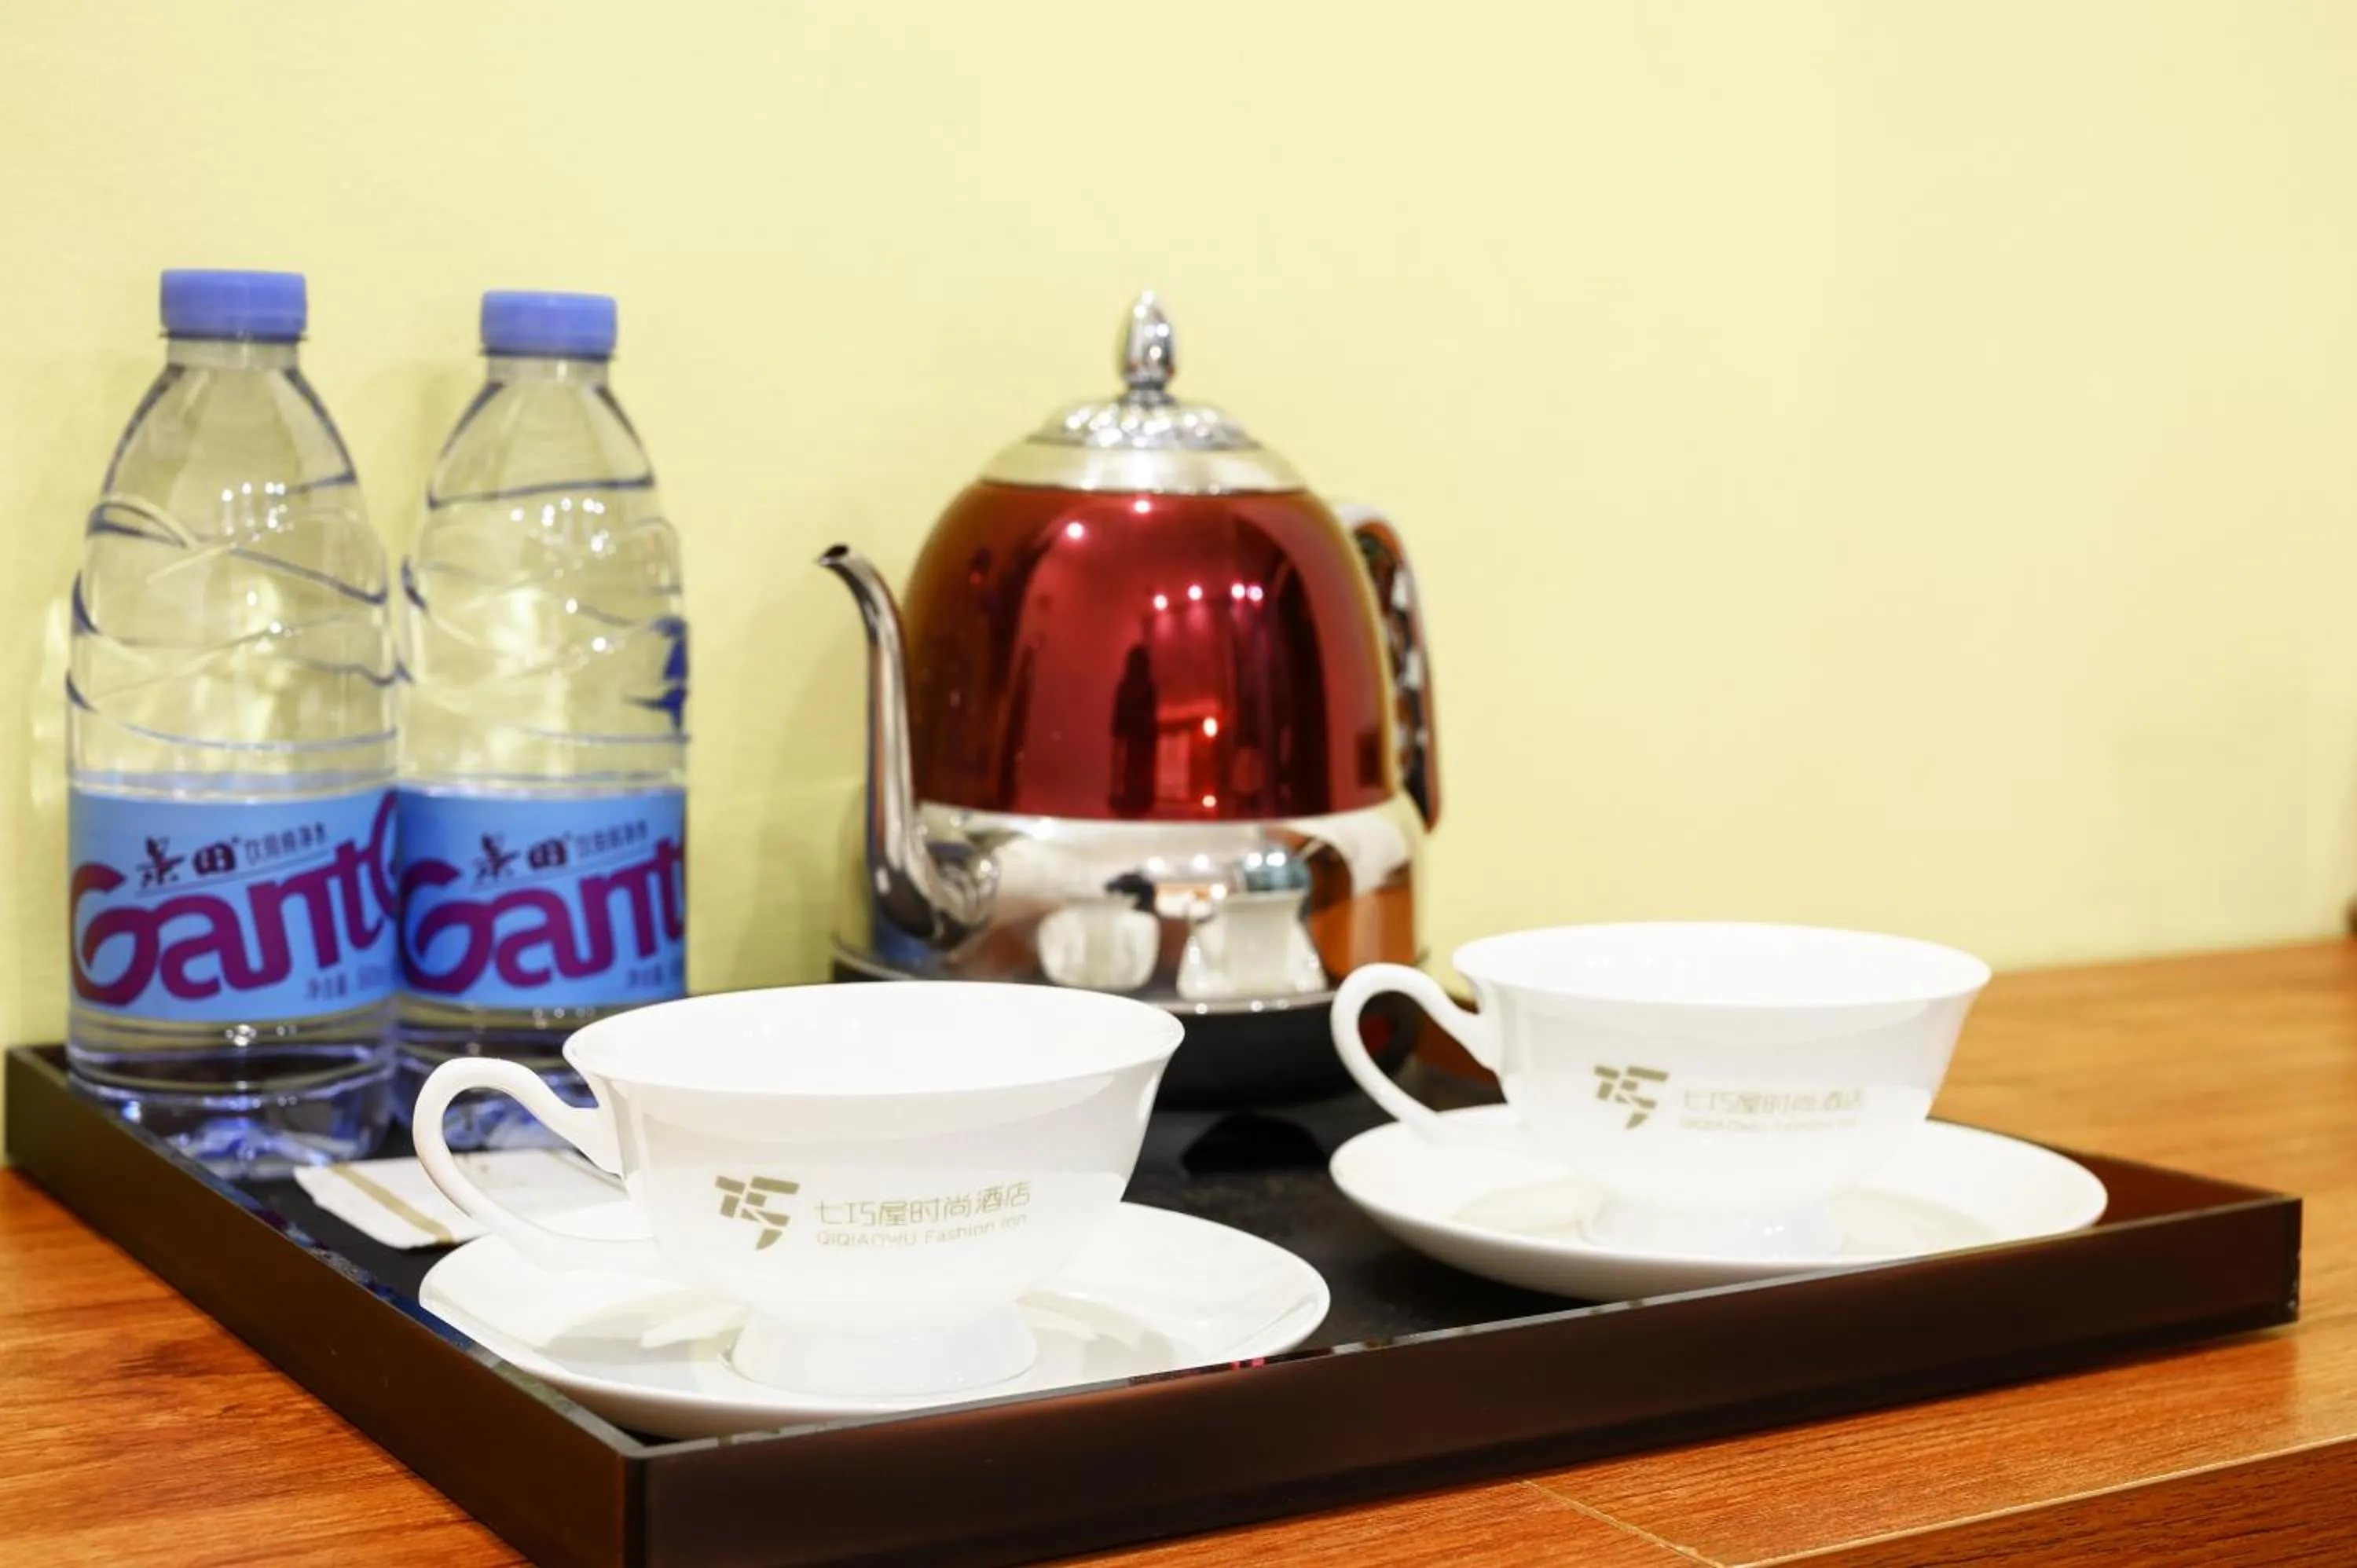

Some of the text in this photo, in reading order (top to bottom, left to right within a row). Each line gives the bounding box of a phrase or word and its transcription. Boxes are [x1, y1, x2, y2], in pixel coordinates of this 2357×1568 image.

[814, 1180, 1032, 1227] 七巧屋时尚酒店
[925, 1222, 995, 1245] Fashion
